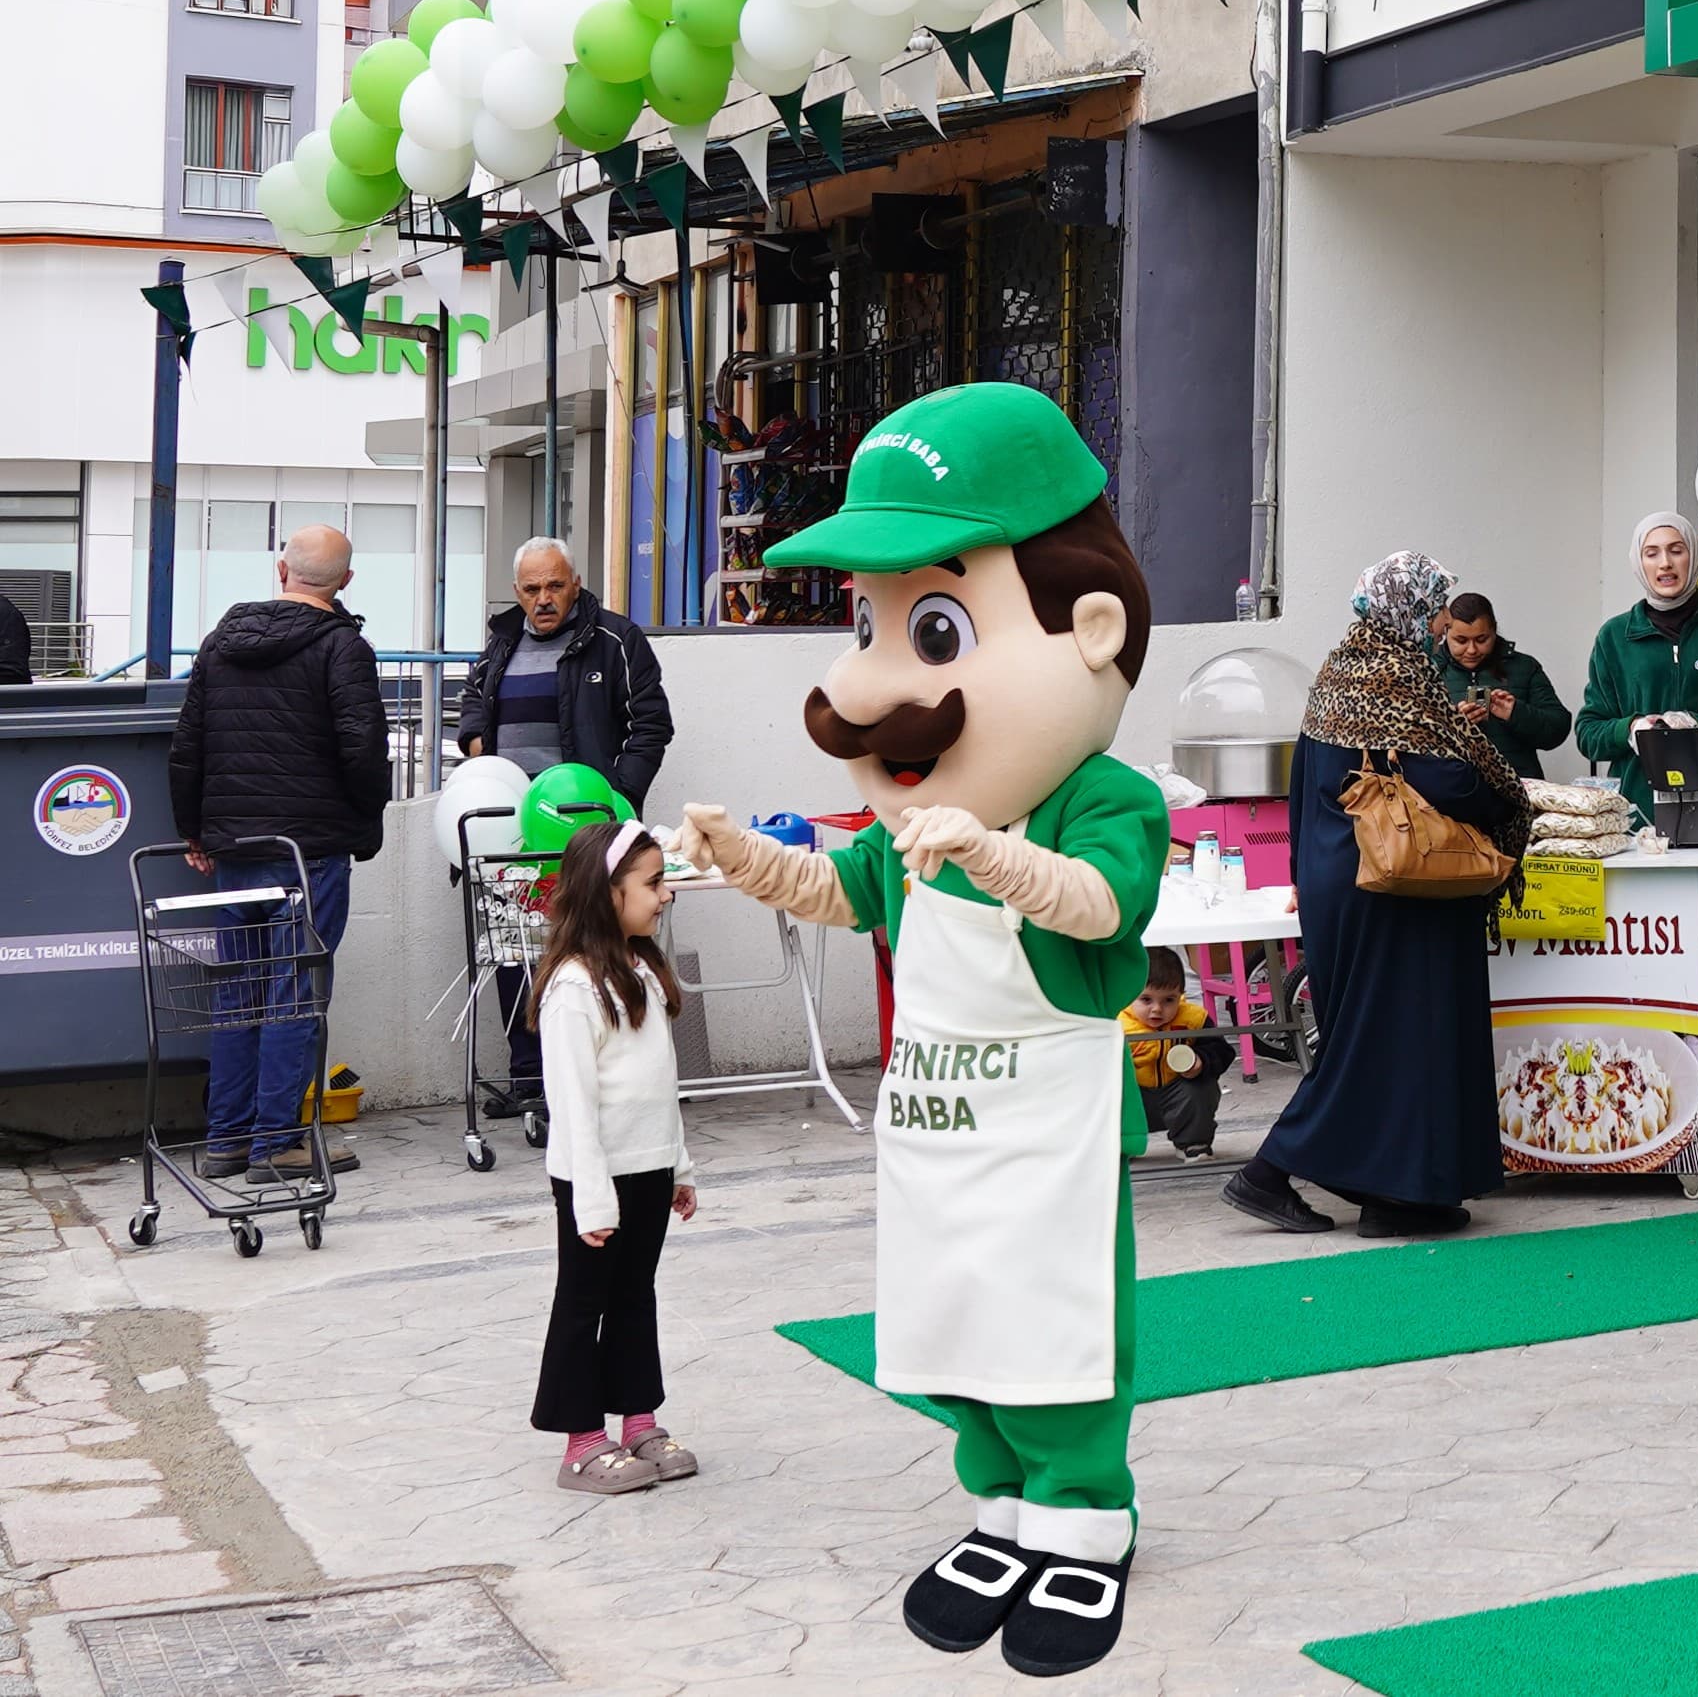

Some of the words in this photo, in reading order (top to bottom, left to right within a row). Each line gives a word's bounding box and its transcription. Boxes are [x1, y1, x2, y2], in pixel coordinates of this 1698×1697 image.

[907, 438, 950, 482] BABA
[43, 825, 72, 850] KÖRFEZ
[78, 821, 122, 852] BELEDİYESİ
[1528, 861, 1560, 873] FIRSAT
[1563, 863, 1596, 874] ÜRÜNÜ
[38, 941, 99, 959] TEMİZLİK
[890, 1091, 977, 1131] BABA
